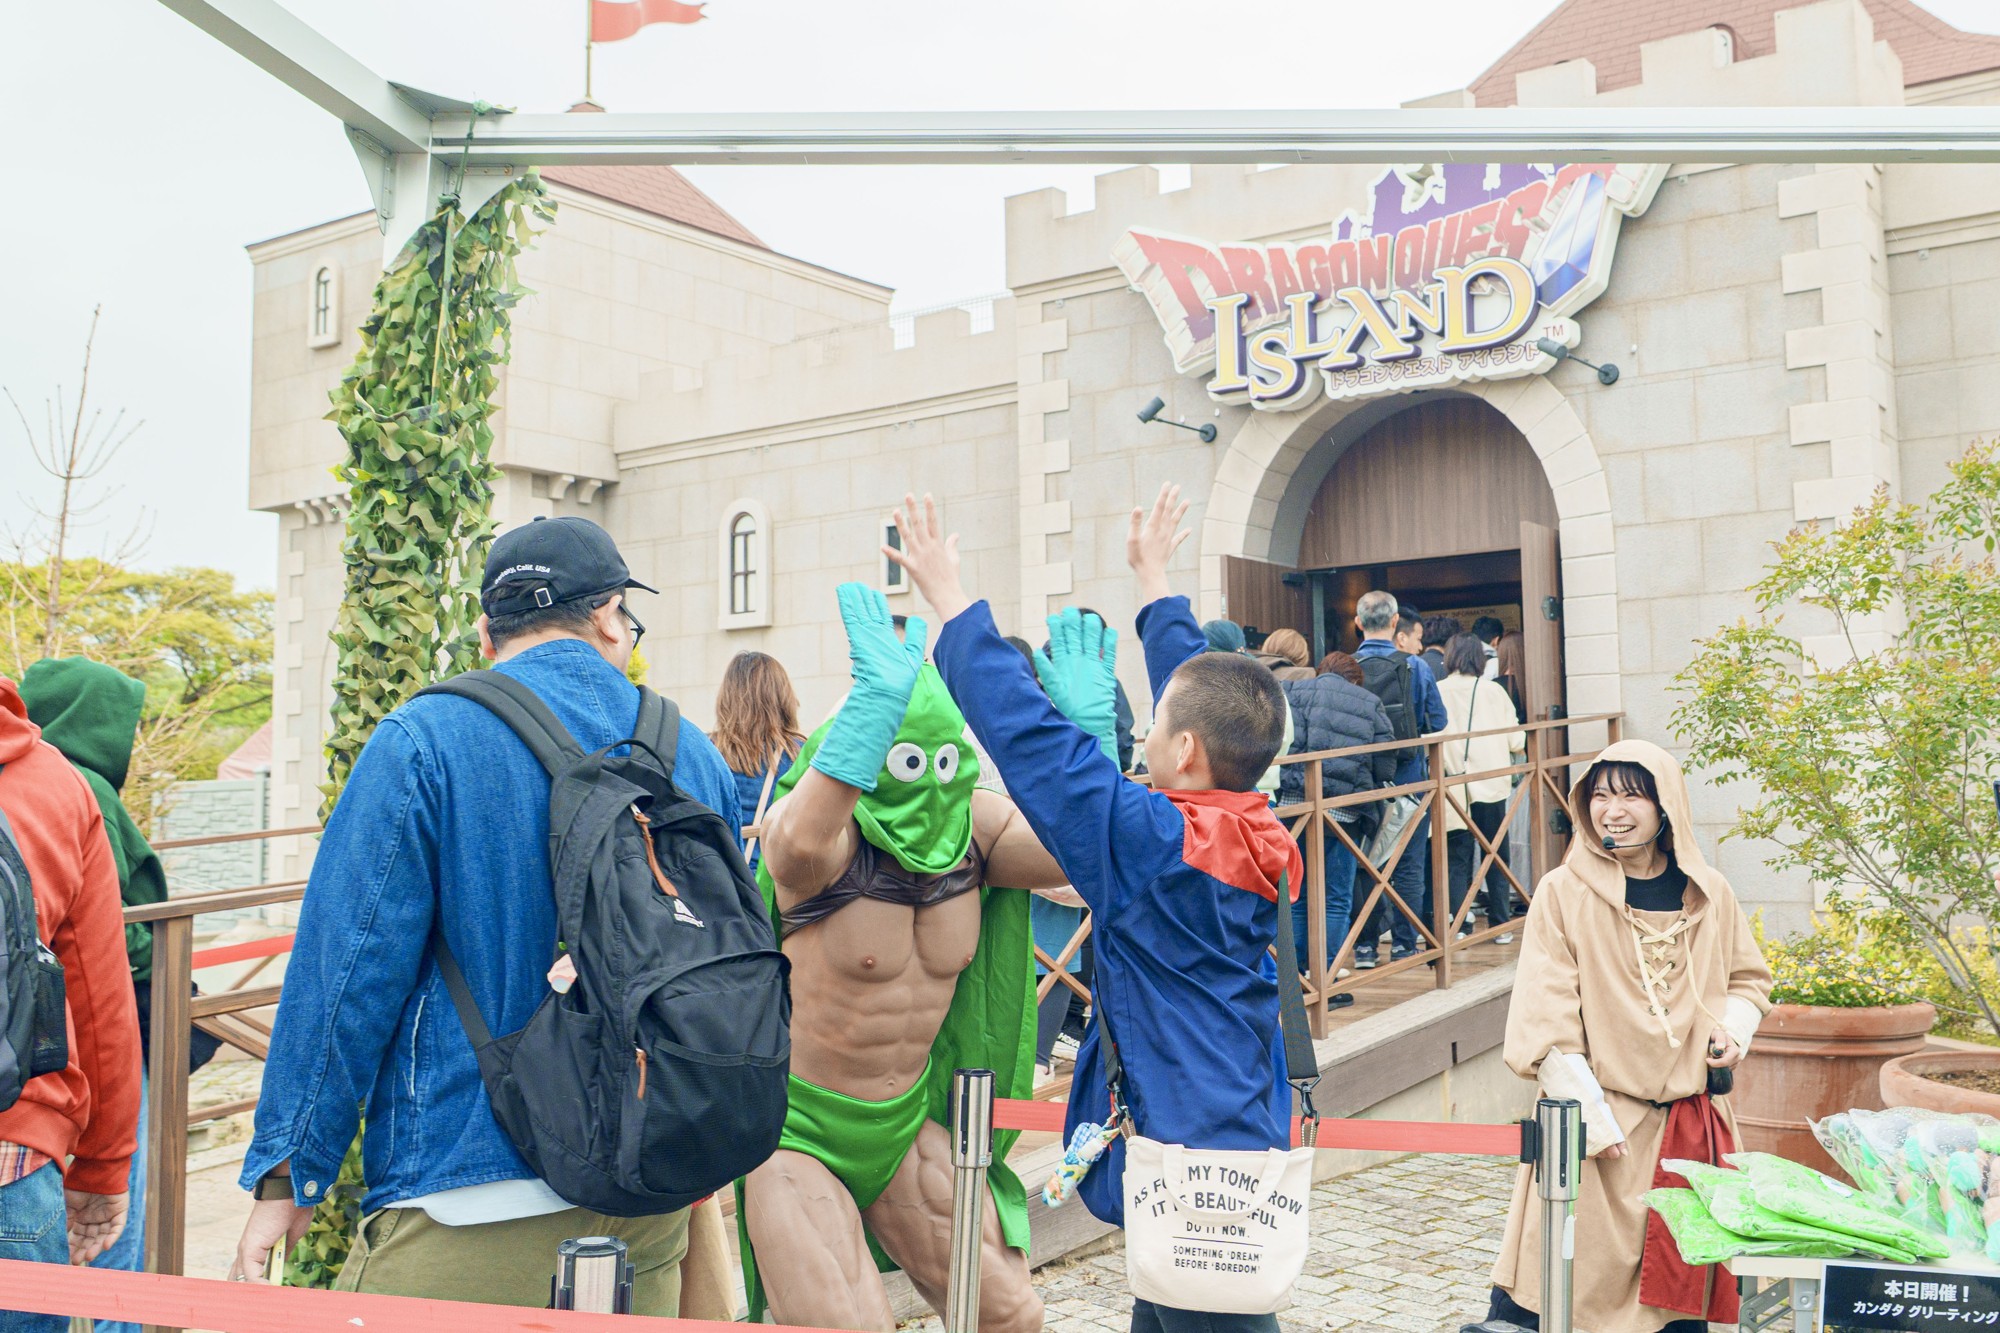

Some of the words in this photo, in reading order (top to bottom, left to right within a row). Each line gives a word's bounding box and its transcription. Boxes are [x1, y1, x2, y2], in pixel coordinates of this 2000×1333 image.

[1128, 230, 1393, 344] DRAGON
[1205, 257, 1539, 401] ISLAND
[1543, 323, 1565, 338] TM
[1331, 354, 1452, 391] ドラゴンクエスト
[1459, 340, 1541, 370] アイランド
[535, 565, 550, 573] USA
[1057, 1032, 1080, 1049] HOKA
[1134, 1187, 1148, 1209] AS
[1188, 1165, 1212, 1182] MY
[1219, 1167, 1303, 1215] TOMOROW
[1152, 1200, 1166, 1217] IT
[1195, 1191, 1278, 1230] BEAUTFUL
[1186, 1221, 1201, 1233] DO
[1222, 1225, 1250, 1238] NOW.
[1173, 1245, 1223, 1259] SOMETHING
[1175, 1258, 1208, 1270] BEFORE
[1884, 1280, 1969, 1303] 本日開催！
[1853, 1301, 1905, 1317] カンダタ
[1908, 1305, 1999, 1325] グリーティング
